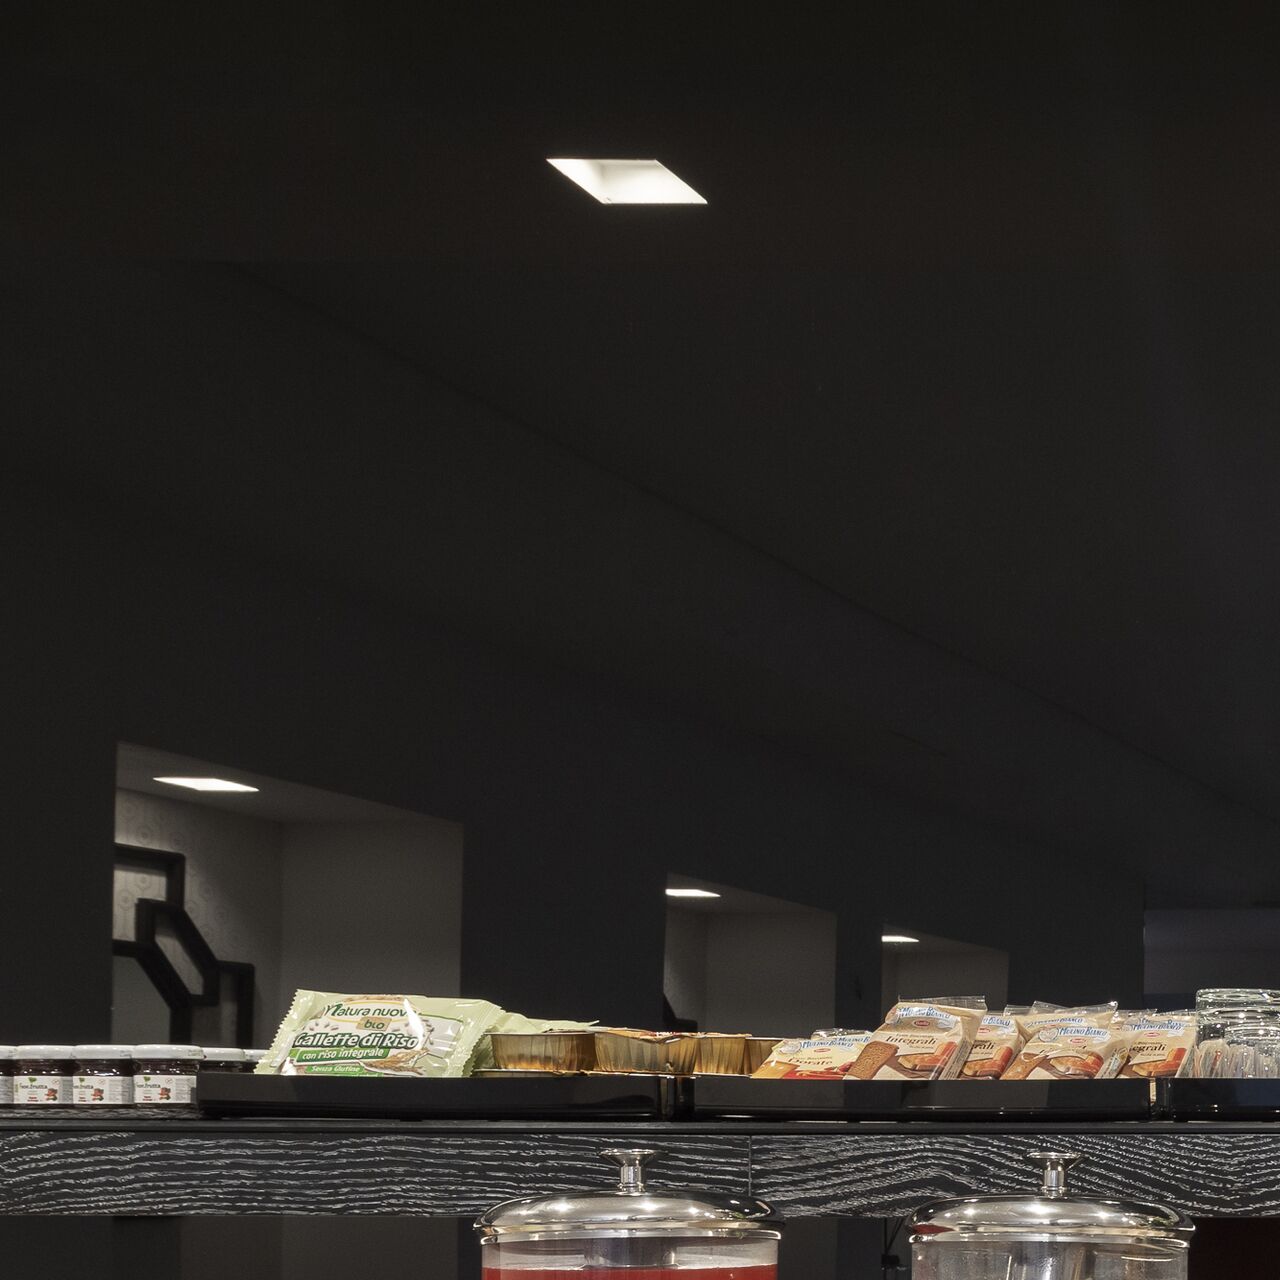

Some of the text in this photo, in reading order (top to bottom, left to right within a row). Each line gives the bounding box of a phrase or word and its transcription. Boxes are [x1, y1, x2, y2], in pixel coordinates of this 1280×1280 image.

[324, 1002, 371, 1017] Natura
[364, 1019, 385, 1030] bio
[360, 1033, 380, 1048] di
[381, 1034, 420, 1049] Riso
[886, 1036, 938, 1045] Integrali
[302, 1048, 384, 1060] con riso integrale
